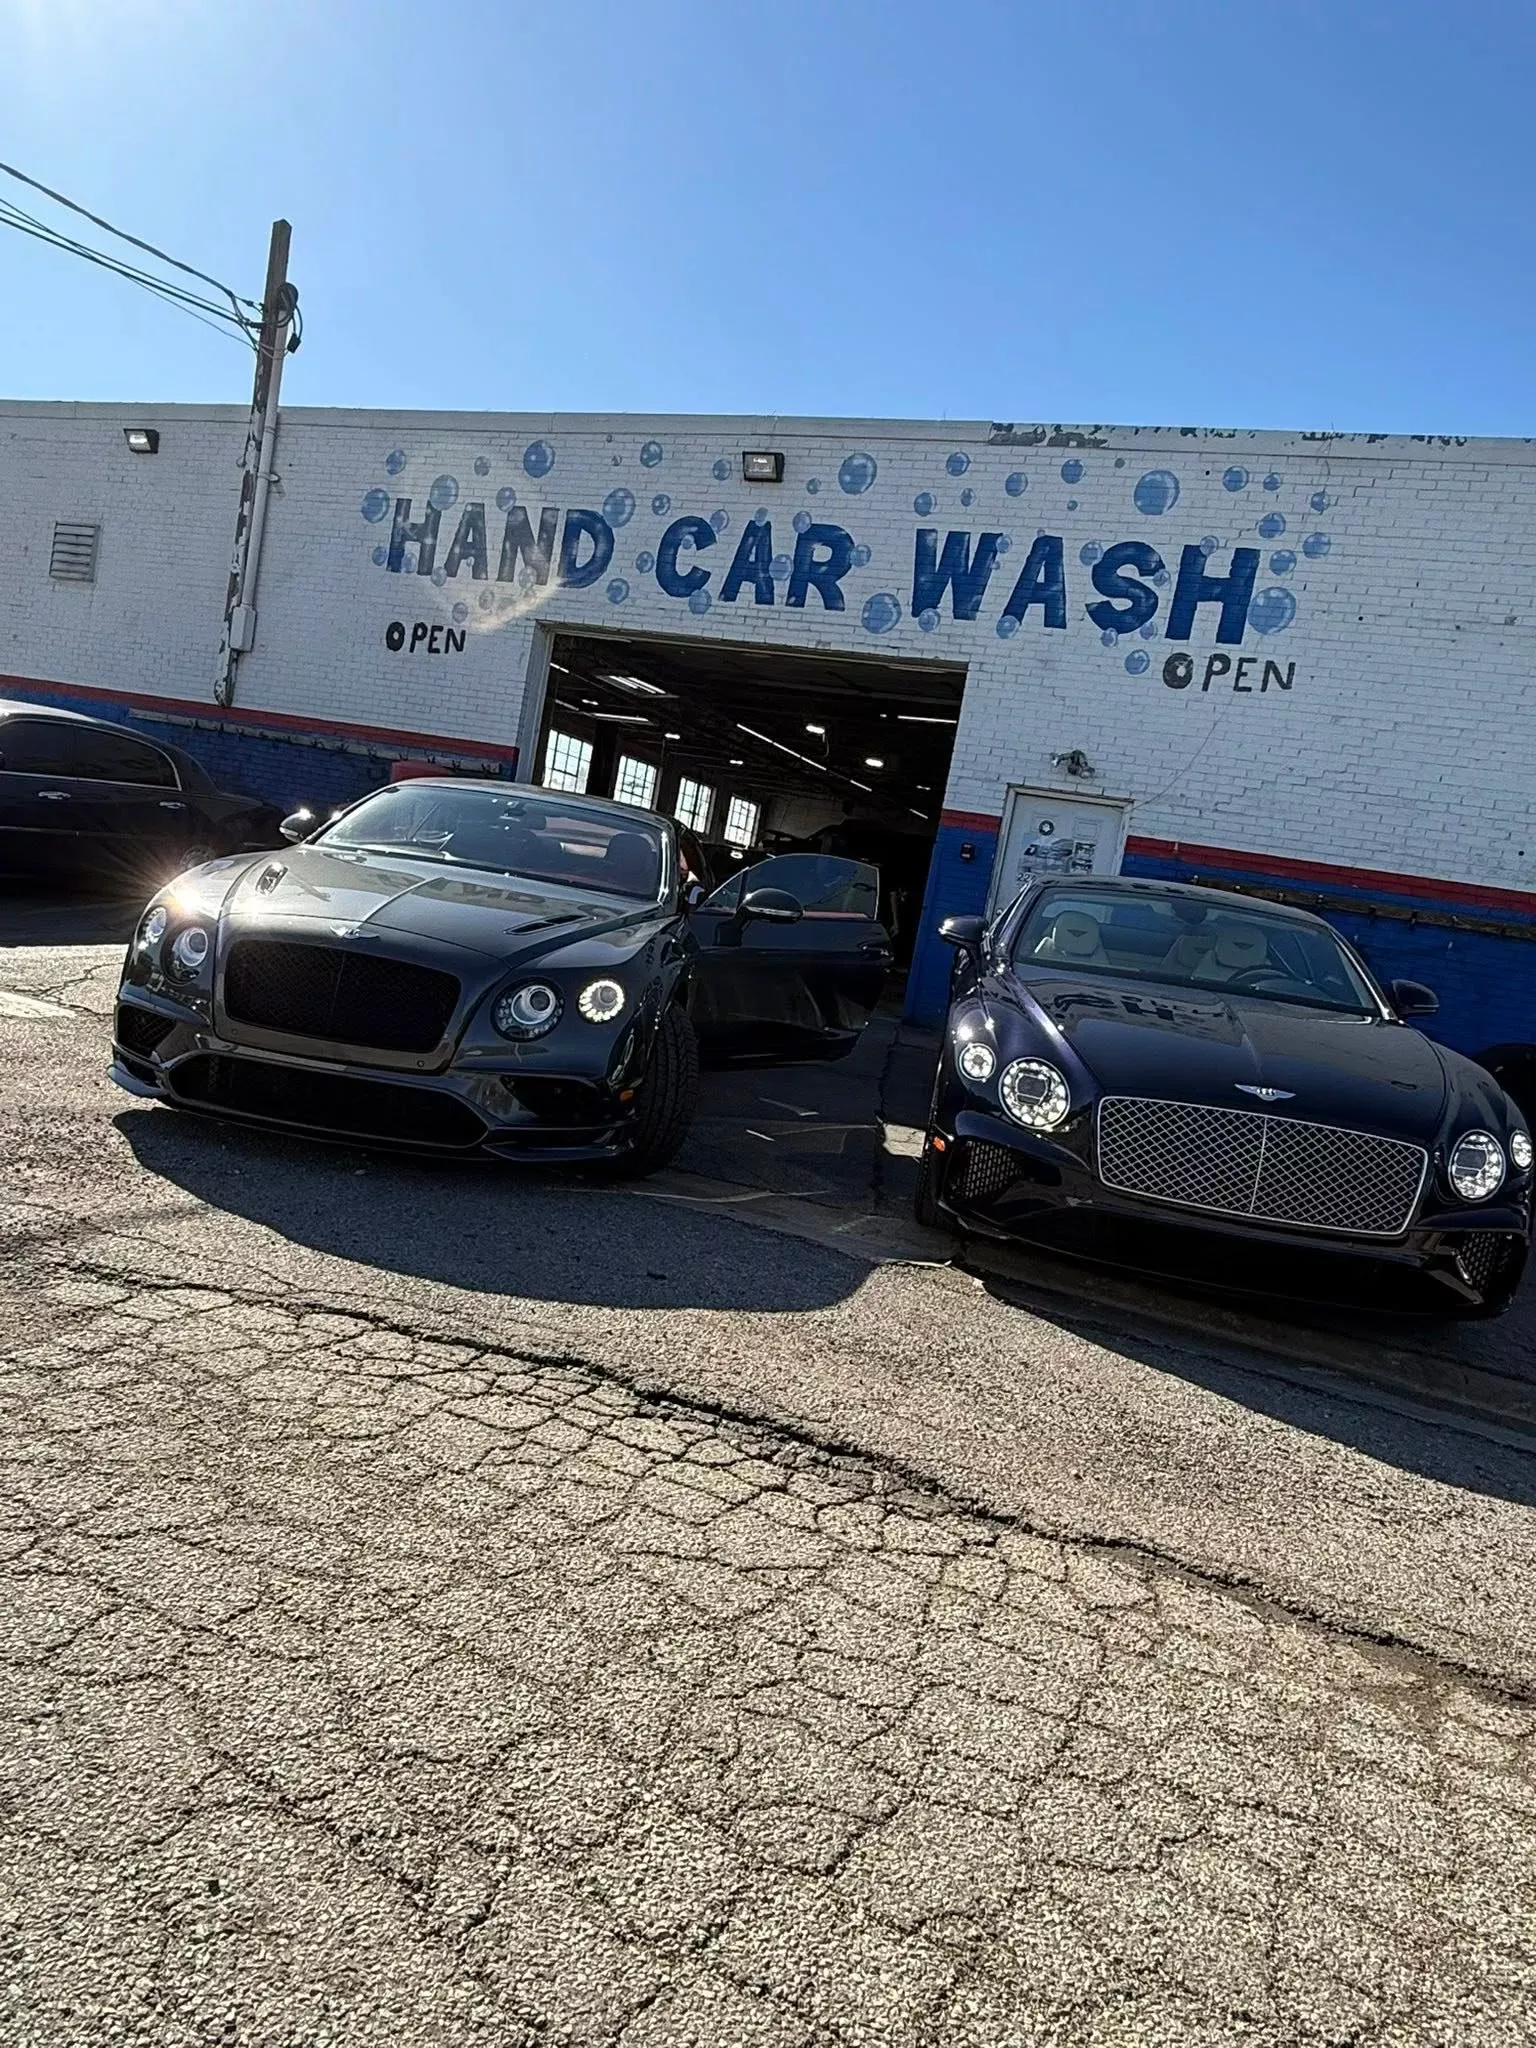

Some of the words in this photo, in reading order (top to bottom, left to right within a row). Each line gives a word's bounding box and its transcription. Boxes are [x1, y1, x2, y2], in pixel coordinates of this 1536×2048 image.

[386, 497, 615, 589] HAND
[655, 515, 855, 612] CAR
[911, 528, 1261, 645] WASH
[386, 621, 467, 655] OPEN
[1163, 651, 1296, 693] OPEN
